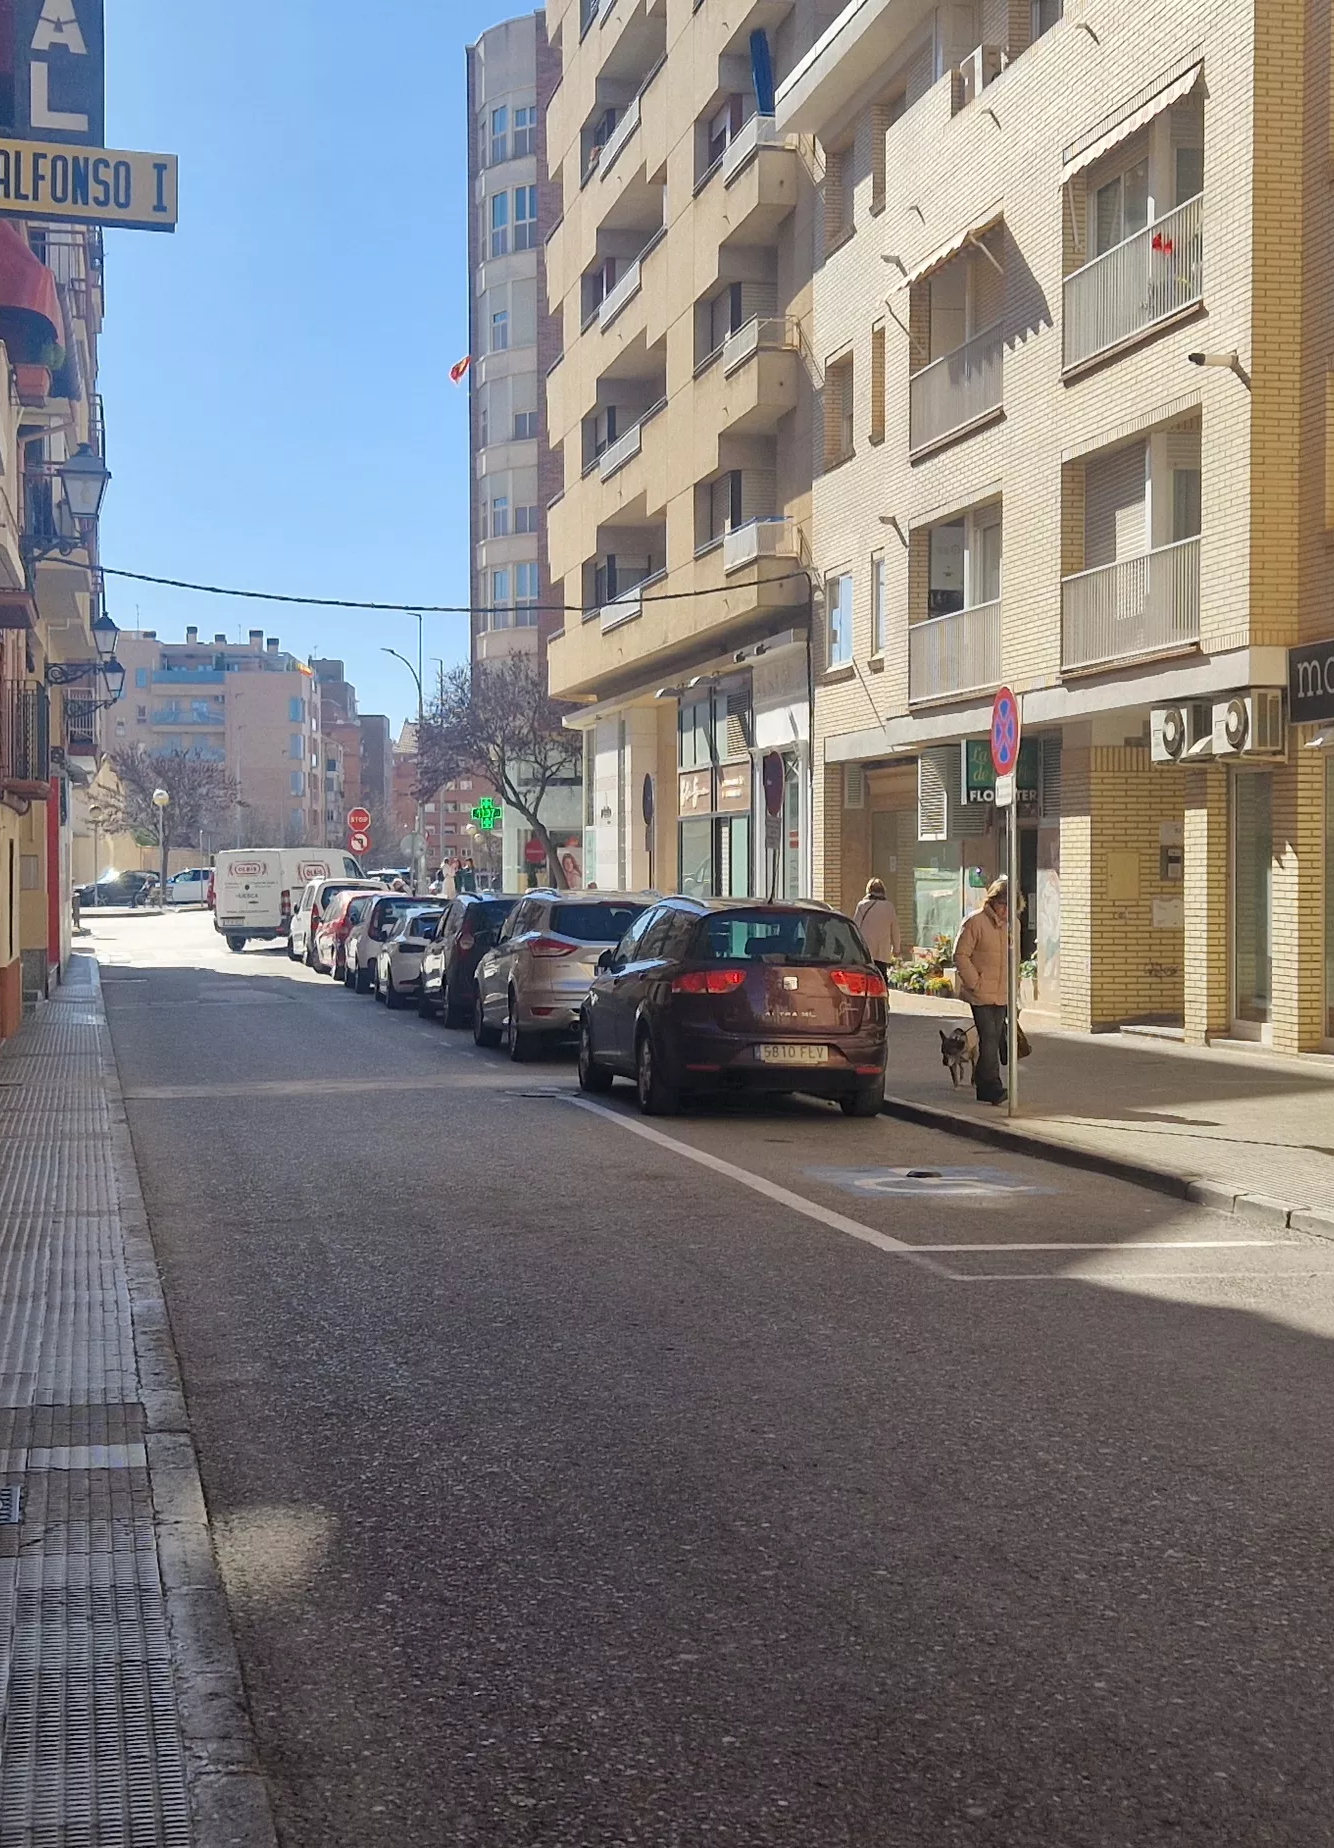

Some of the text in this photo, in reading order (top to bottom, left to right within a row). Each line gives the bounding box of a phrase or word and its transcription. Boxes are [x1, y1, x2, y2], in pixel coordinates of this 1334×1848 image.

[152, 162, 167, 212] I
[350, 816, 369, 824] STOP
[763, 1045, 796, 1059] 5810
